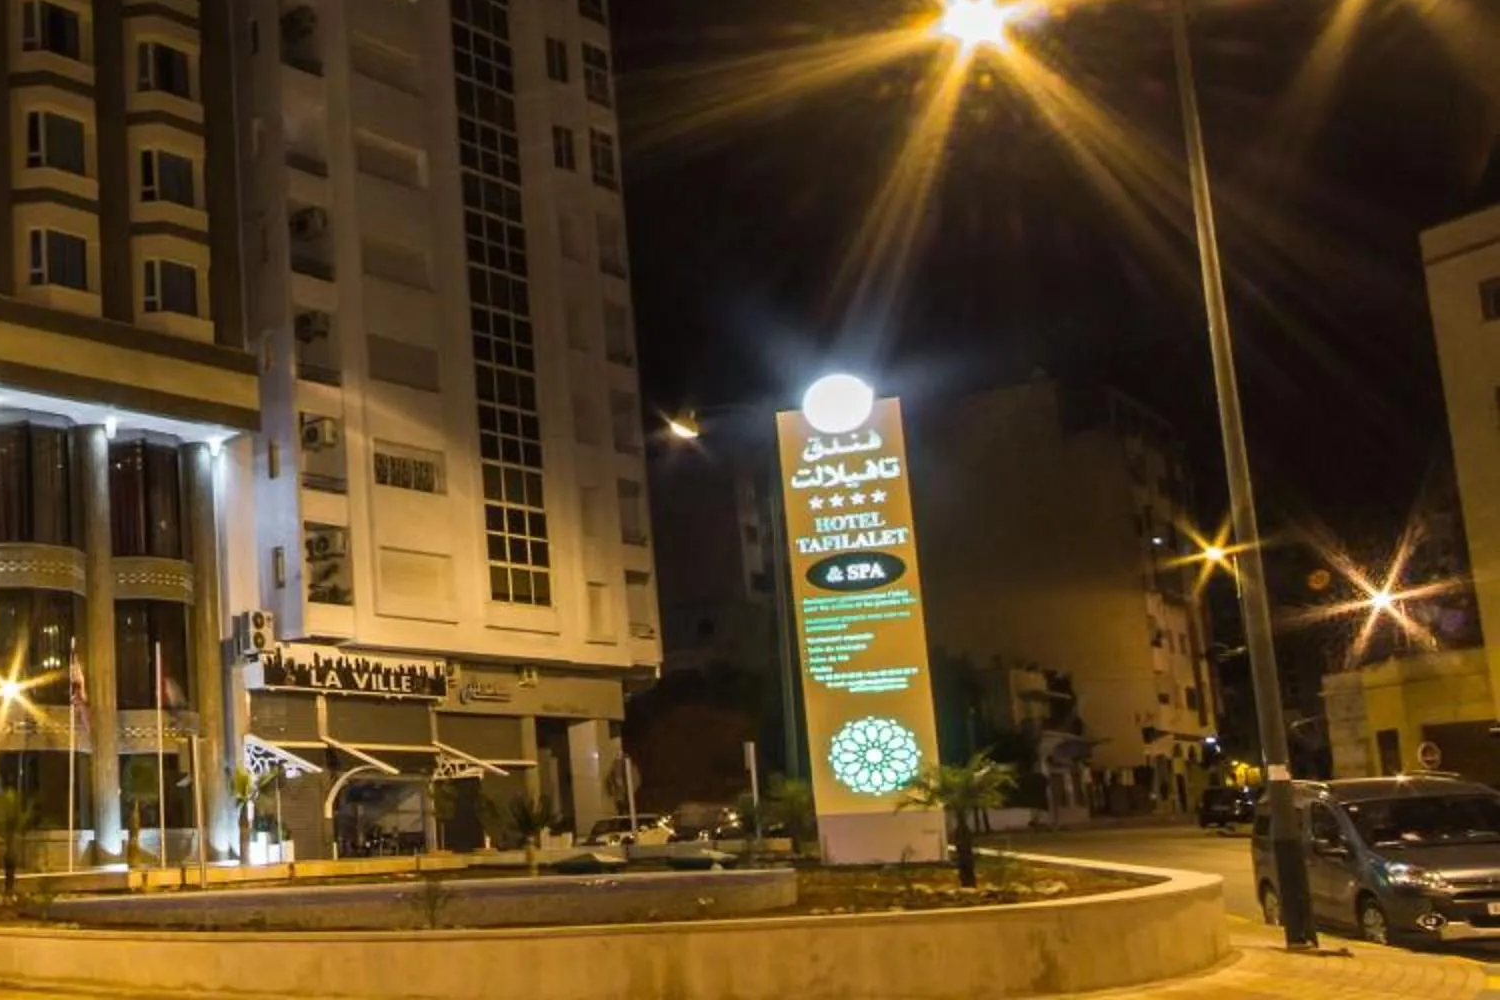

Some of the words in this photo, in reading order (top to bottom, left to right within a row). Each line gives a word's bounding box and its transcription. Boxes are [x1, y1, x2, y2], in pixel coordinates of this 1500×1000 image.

[791, 456, 900, 488] تافيلالت
[815, 512, 886, 533] HOTEL
[796, 528, 908, 553] TAFILALET
[826, 565, 844, 583] &
[846, 562, 886, 581] SPA
[310, 670, 342, 689] LA
[352, 672, 412, 693] VILLE
